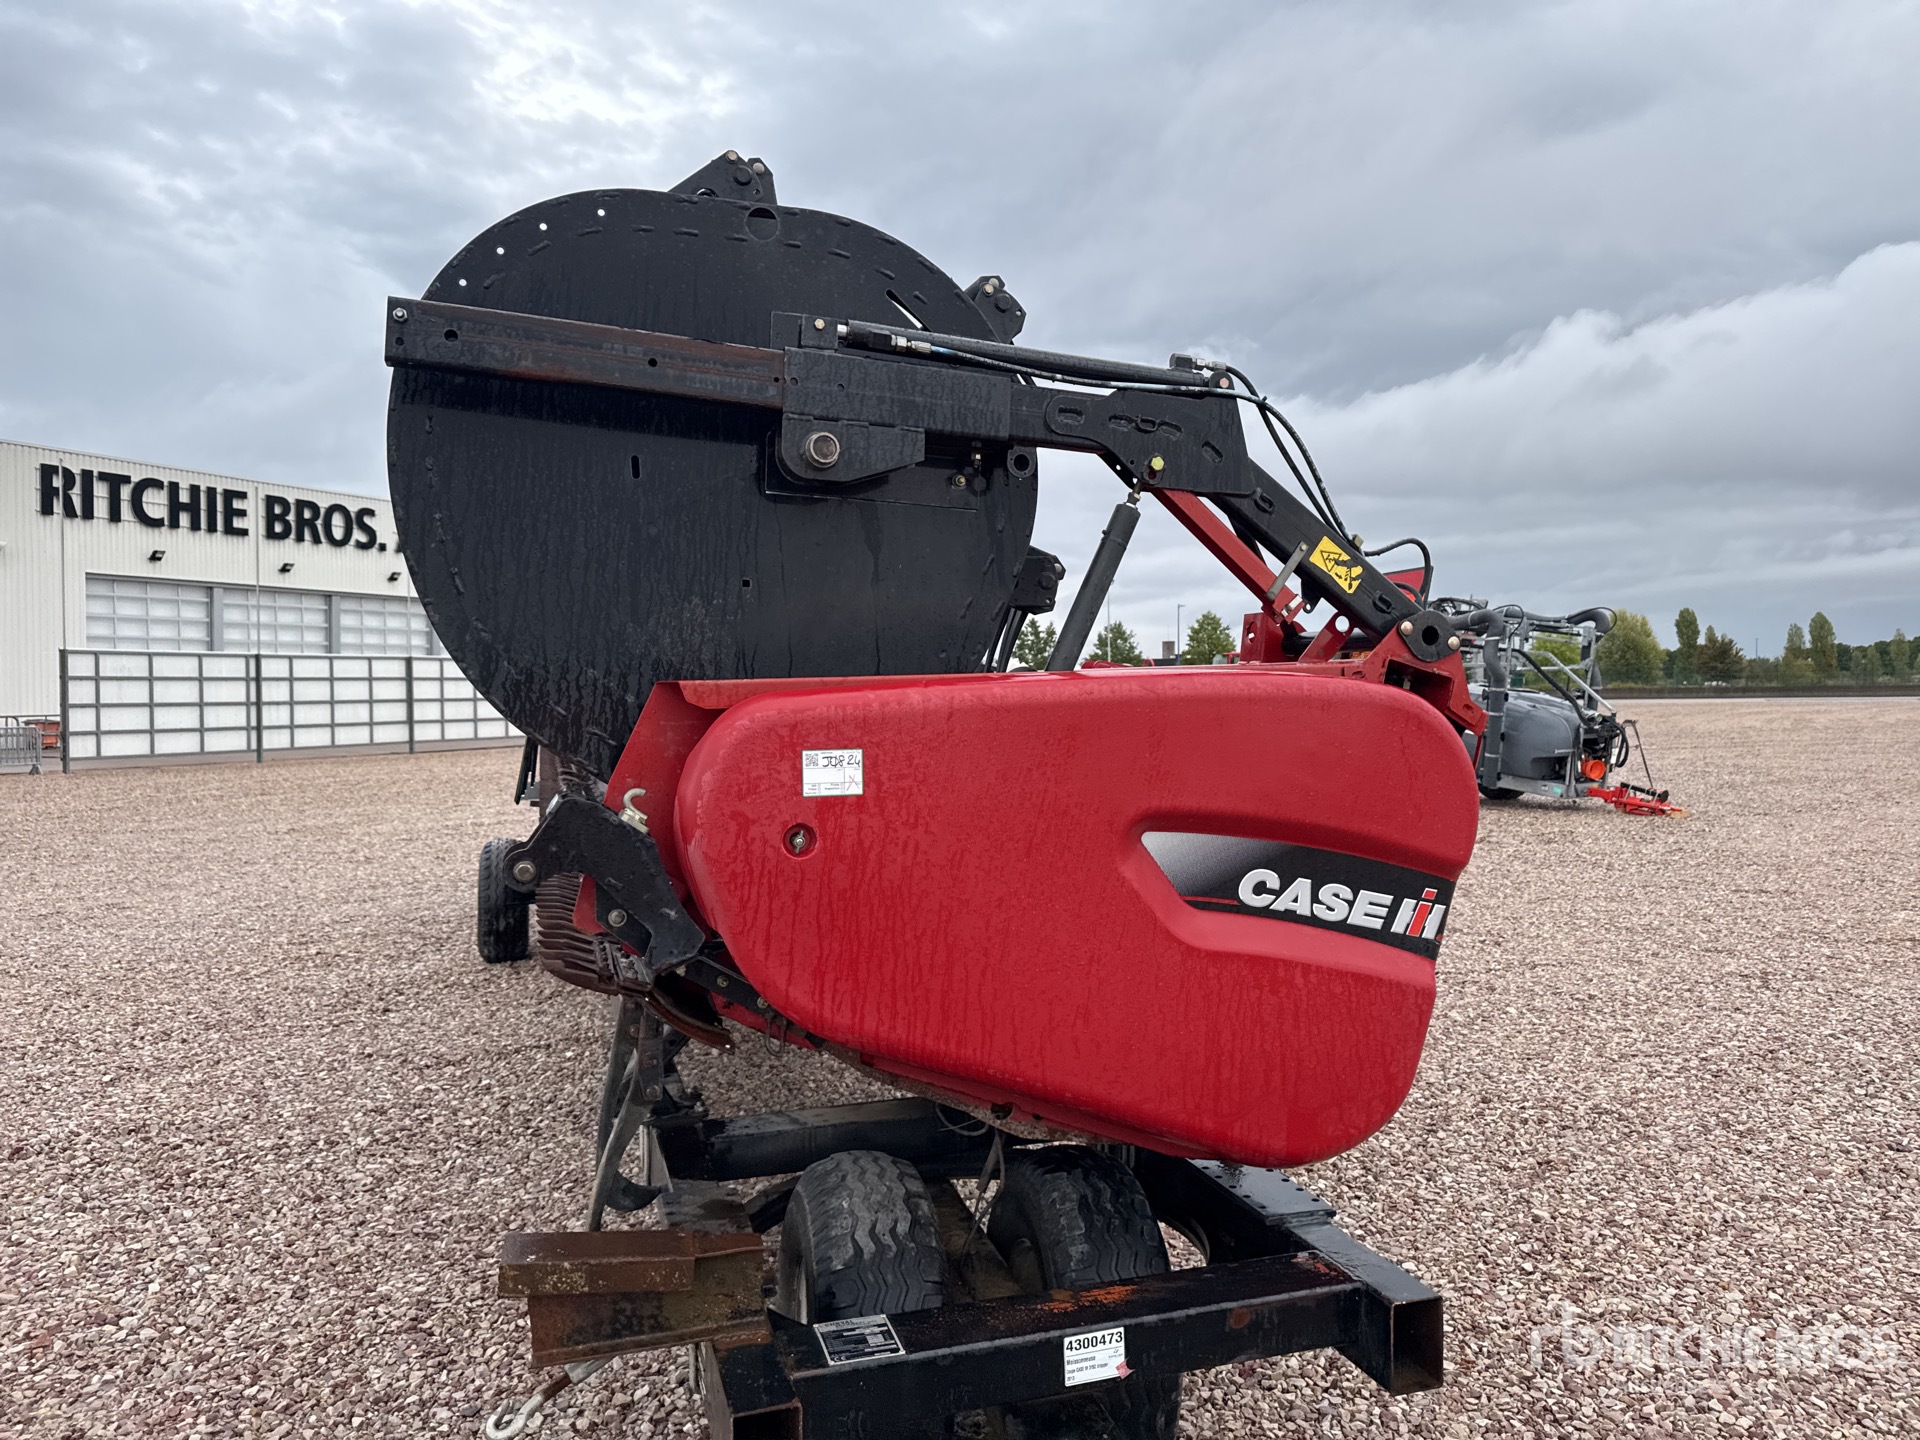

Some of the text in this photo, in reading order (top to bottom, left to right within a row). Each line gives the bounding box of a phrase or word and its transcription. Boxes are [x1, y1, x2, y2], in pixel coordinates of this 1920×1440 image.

[40, 463, 387, 553] RITCHIE BROS.
[1238, 868, 1394, 930] CASE
[1066, 1331, 1122, 1351] 4300473
